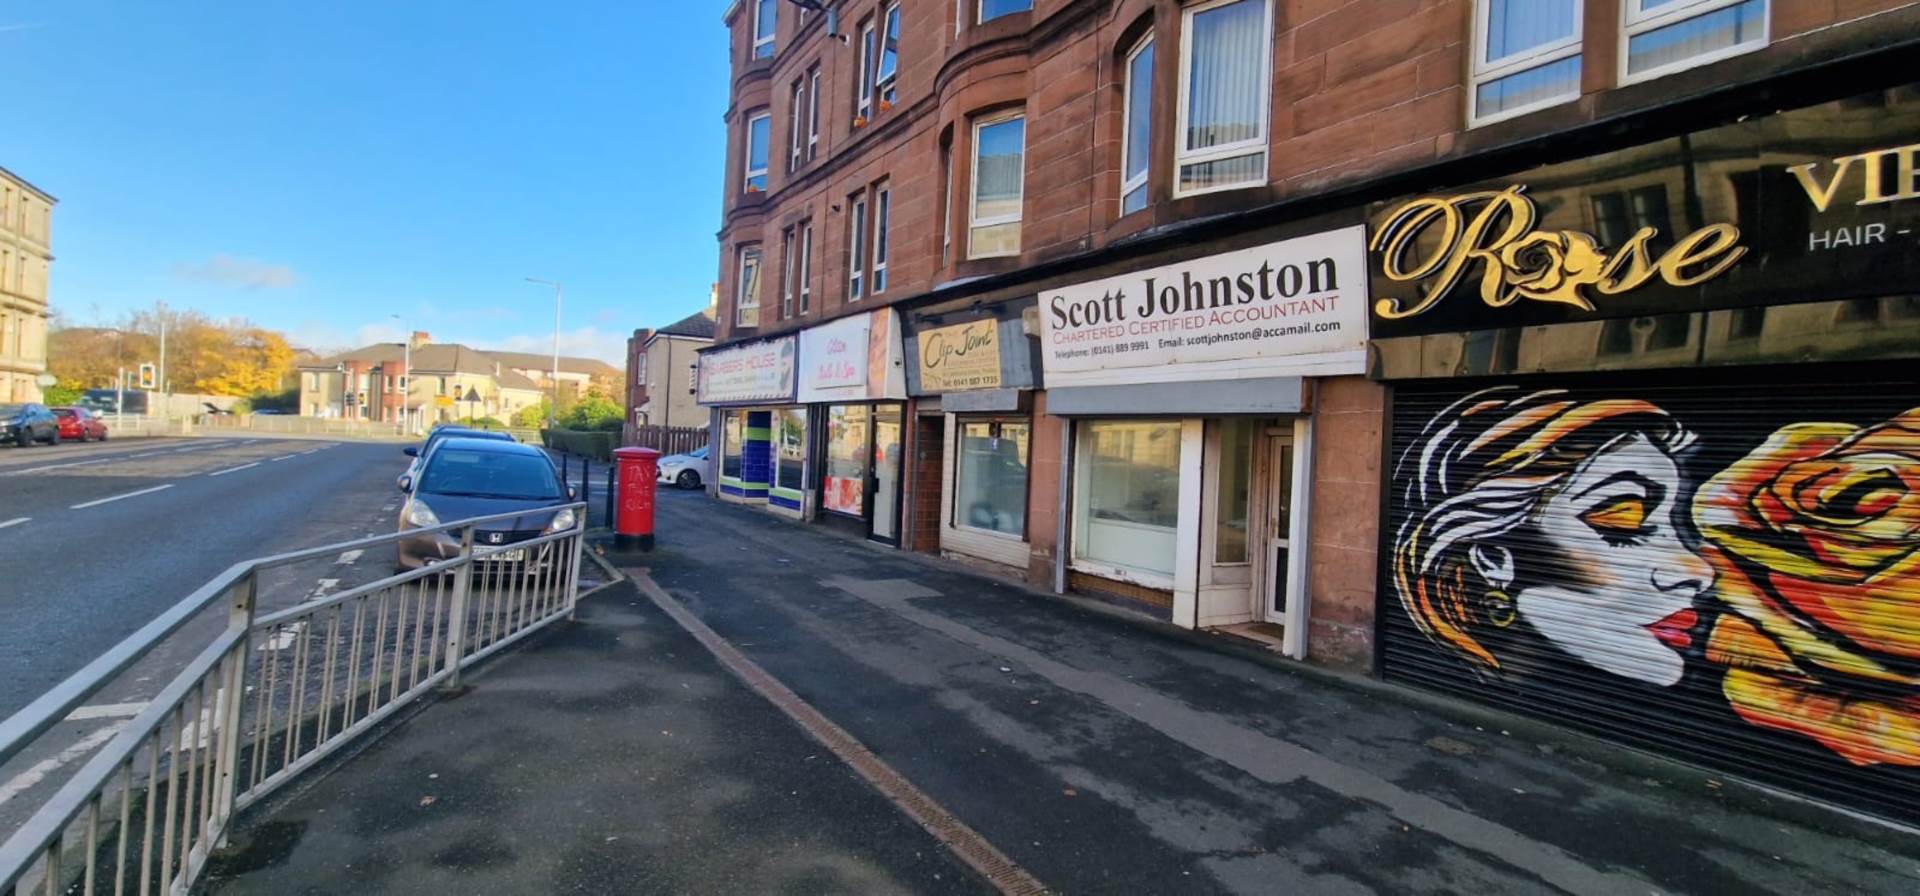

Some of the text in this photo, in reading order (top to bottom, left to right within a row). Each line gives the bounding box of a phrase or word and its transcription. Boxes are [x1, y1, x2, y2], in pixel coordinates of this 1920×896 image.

[1370, 184, 1748, 318] Rose
[1808, 222, 1887, 252] HAIR
[1050, 257, 1340, 331] Scott Johnston
[924, 332, 954, 368] Clip
[955, 319, 994, 356] Joint
[1053, 295, 1340, 345] CHARTERED CERTIFIED ACCOUNTANT
[1130, 341, 1150, 352] 9991
[1158, 337, 1184, 349] Email:
[1186, 320, 1342, 346] scottjohnston@accamail.com
